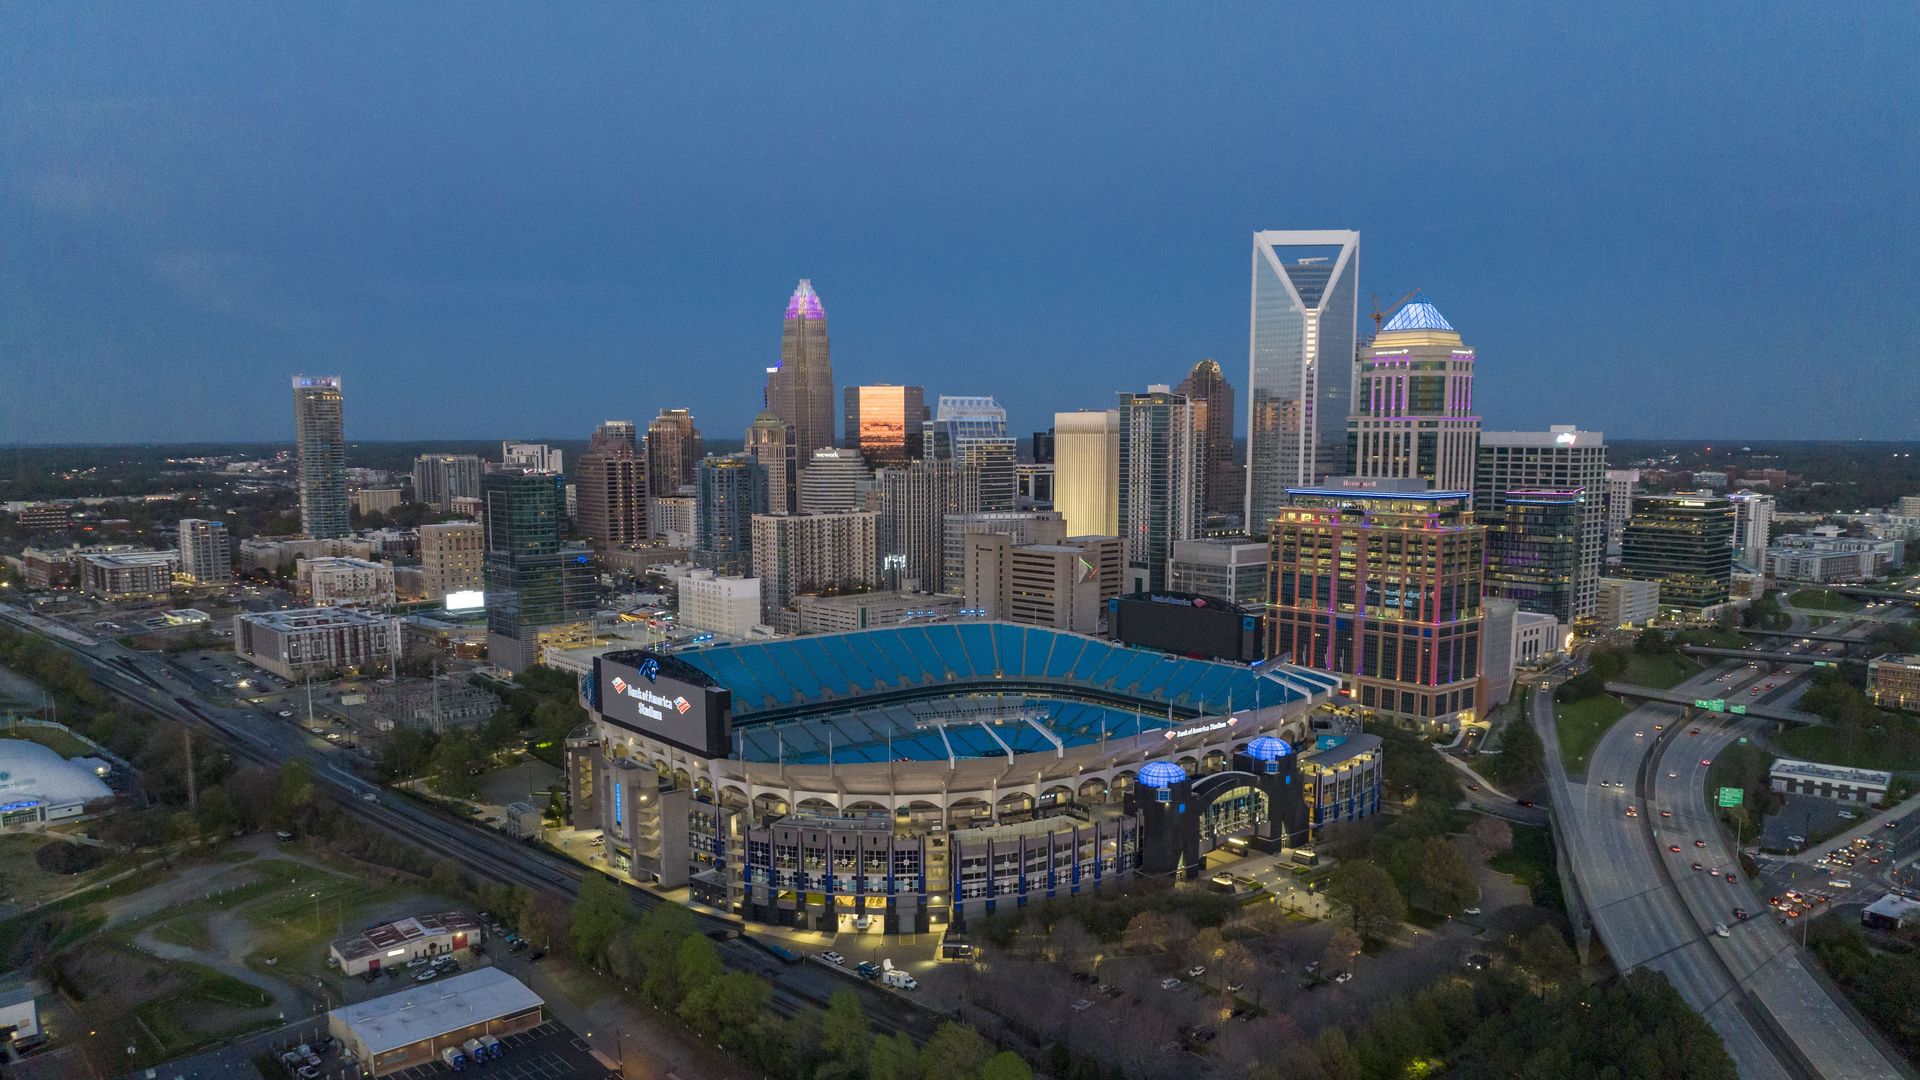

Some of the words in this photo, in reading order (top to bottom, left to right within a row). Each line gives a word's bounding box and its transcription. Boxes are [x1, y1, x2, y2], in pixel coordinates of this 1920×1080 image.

[628, 684, 642, 700] Bank
[638, 702, 662, 720] Stadium
[1177, 730, 1188, 738] Bank
[1193, 726, 1209, 734] America
[1210, 722, 1226, 730] Stadium
